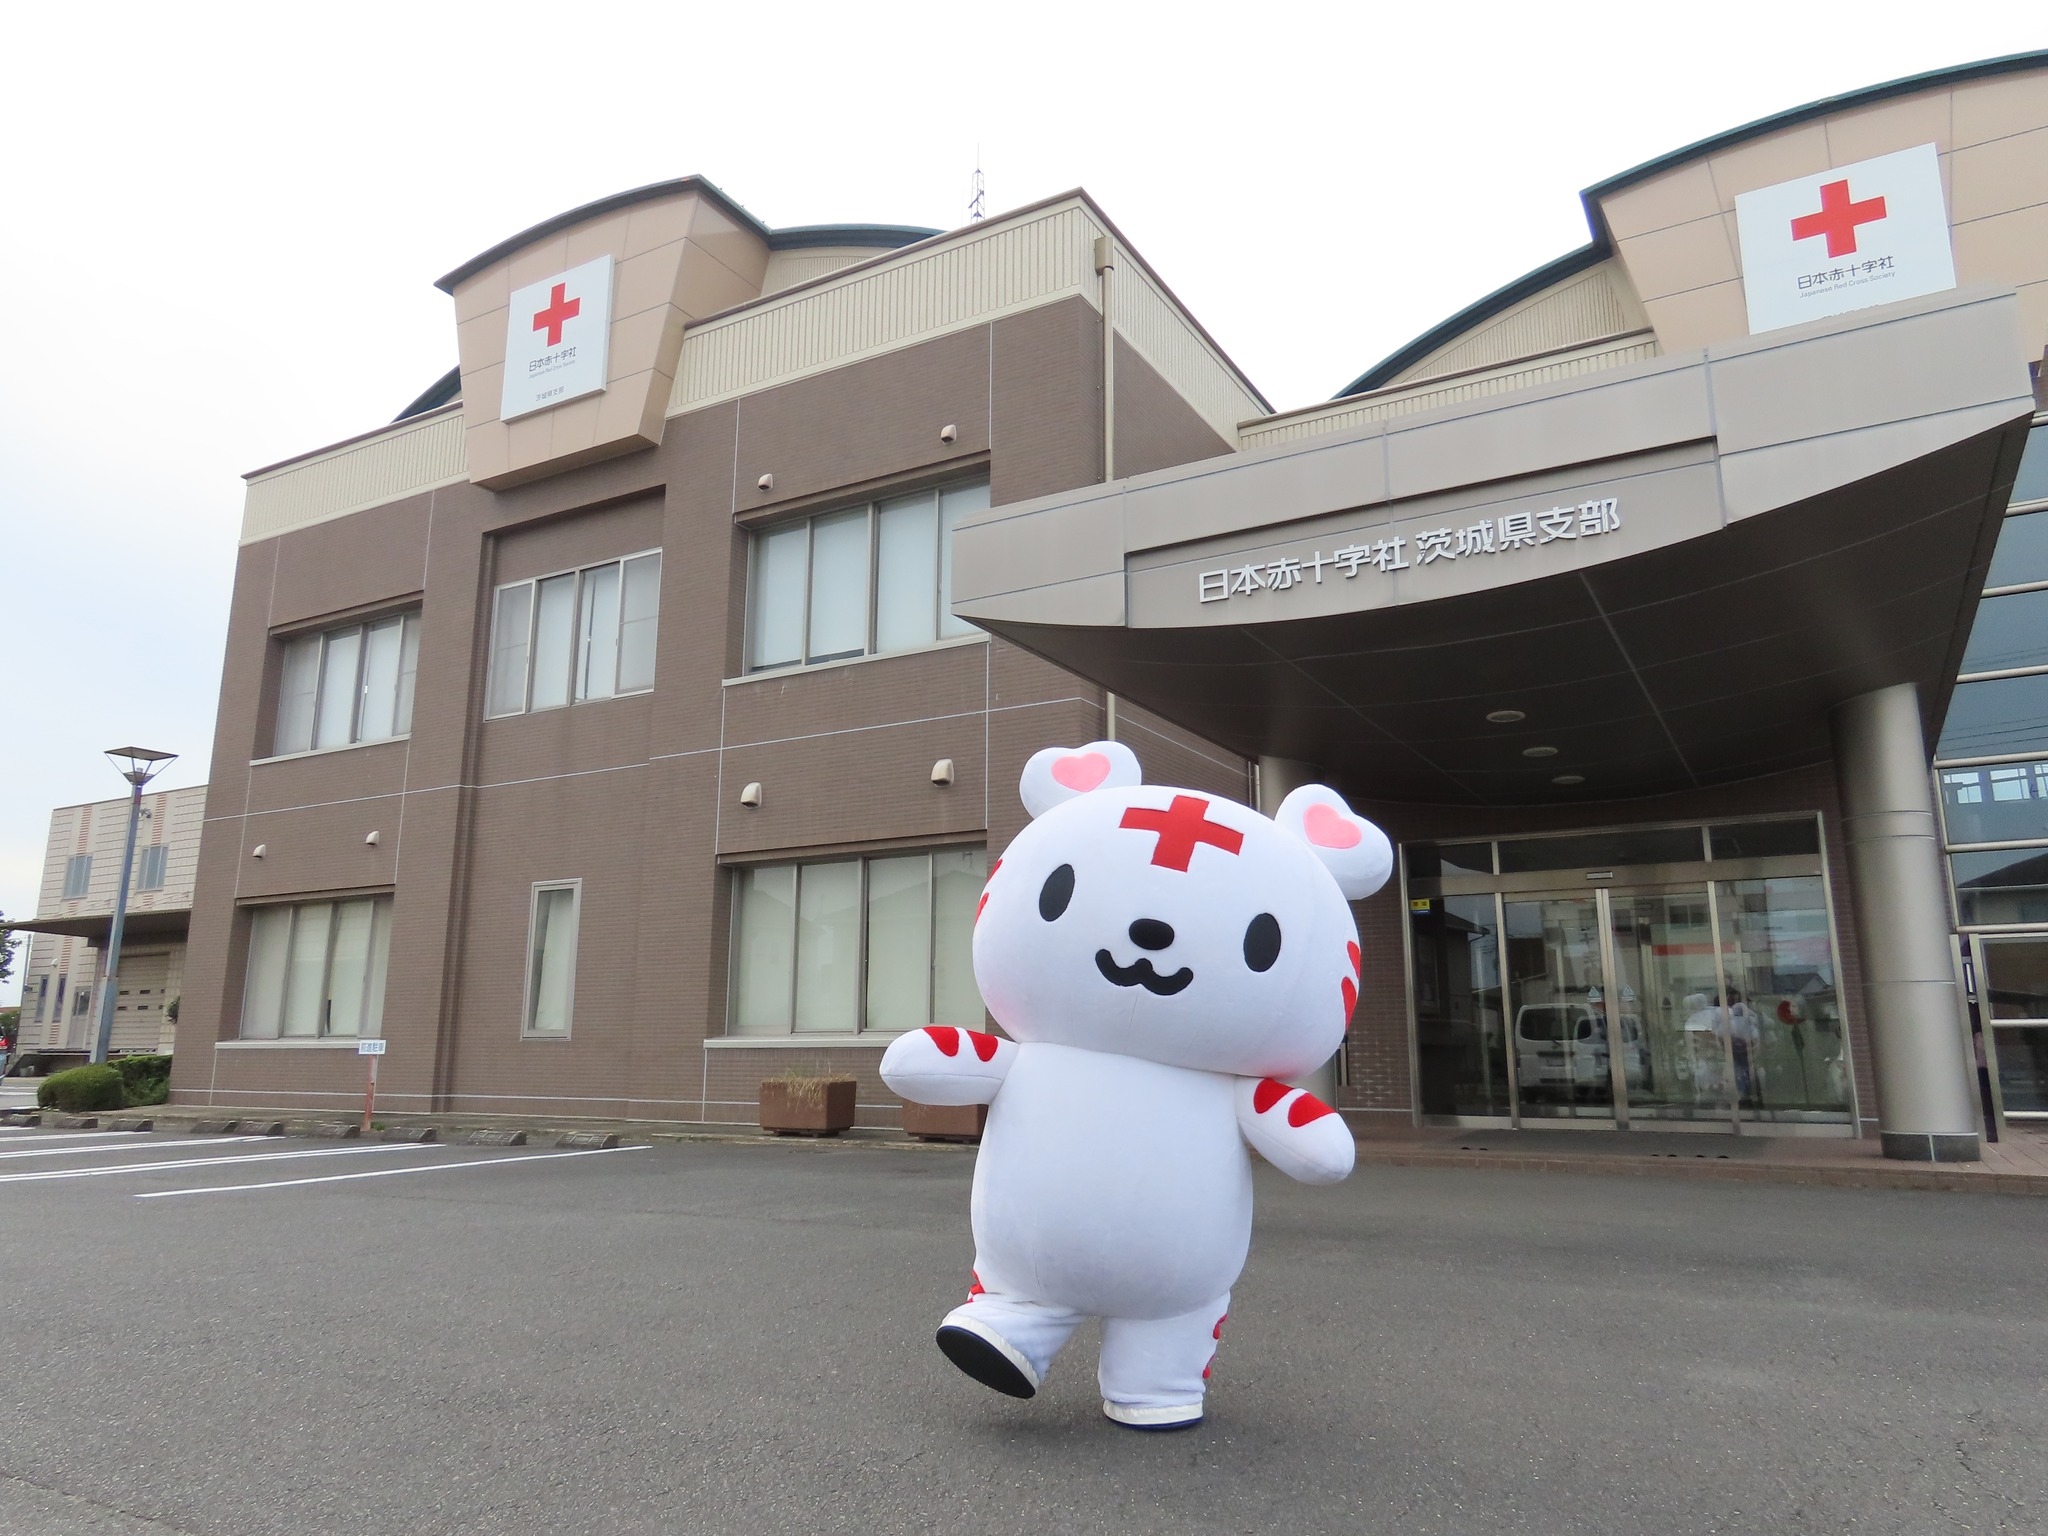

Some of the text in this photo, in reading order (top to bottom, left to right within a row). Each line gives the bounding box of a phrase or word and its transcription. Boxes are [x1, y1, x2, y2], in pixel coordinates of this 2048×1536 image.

[1798, 255, 1894, 290] 日本赤十字社
[1799, 271, 1896, 298] Japanese Red Cross Society
[529, 346, 576, 372] 日本赤十字社
[1198, 497, 1621, 604] 日本赤十字社 茨城県支部
